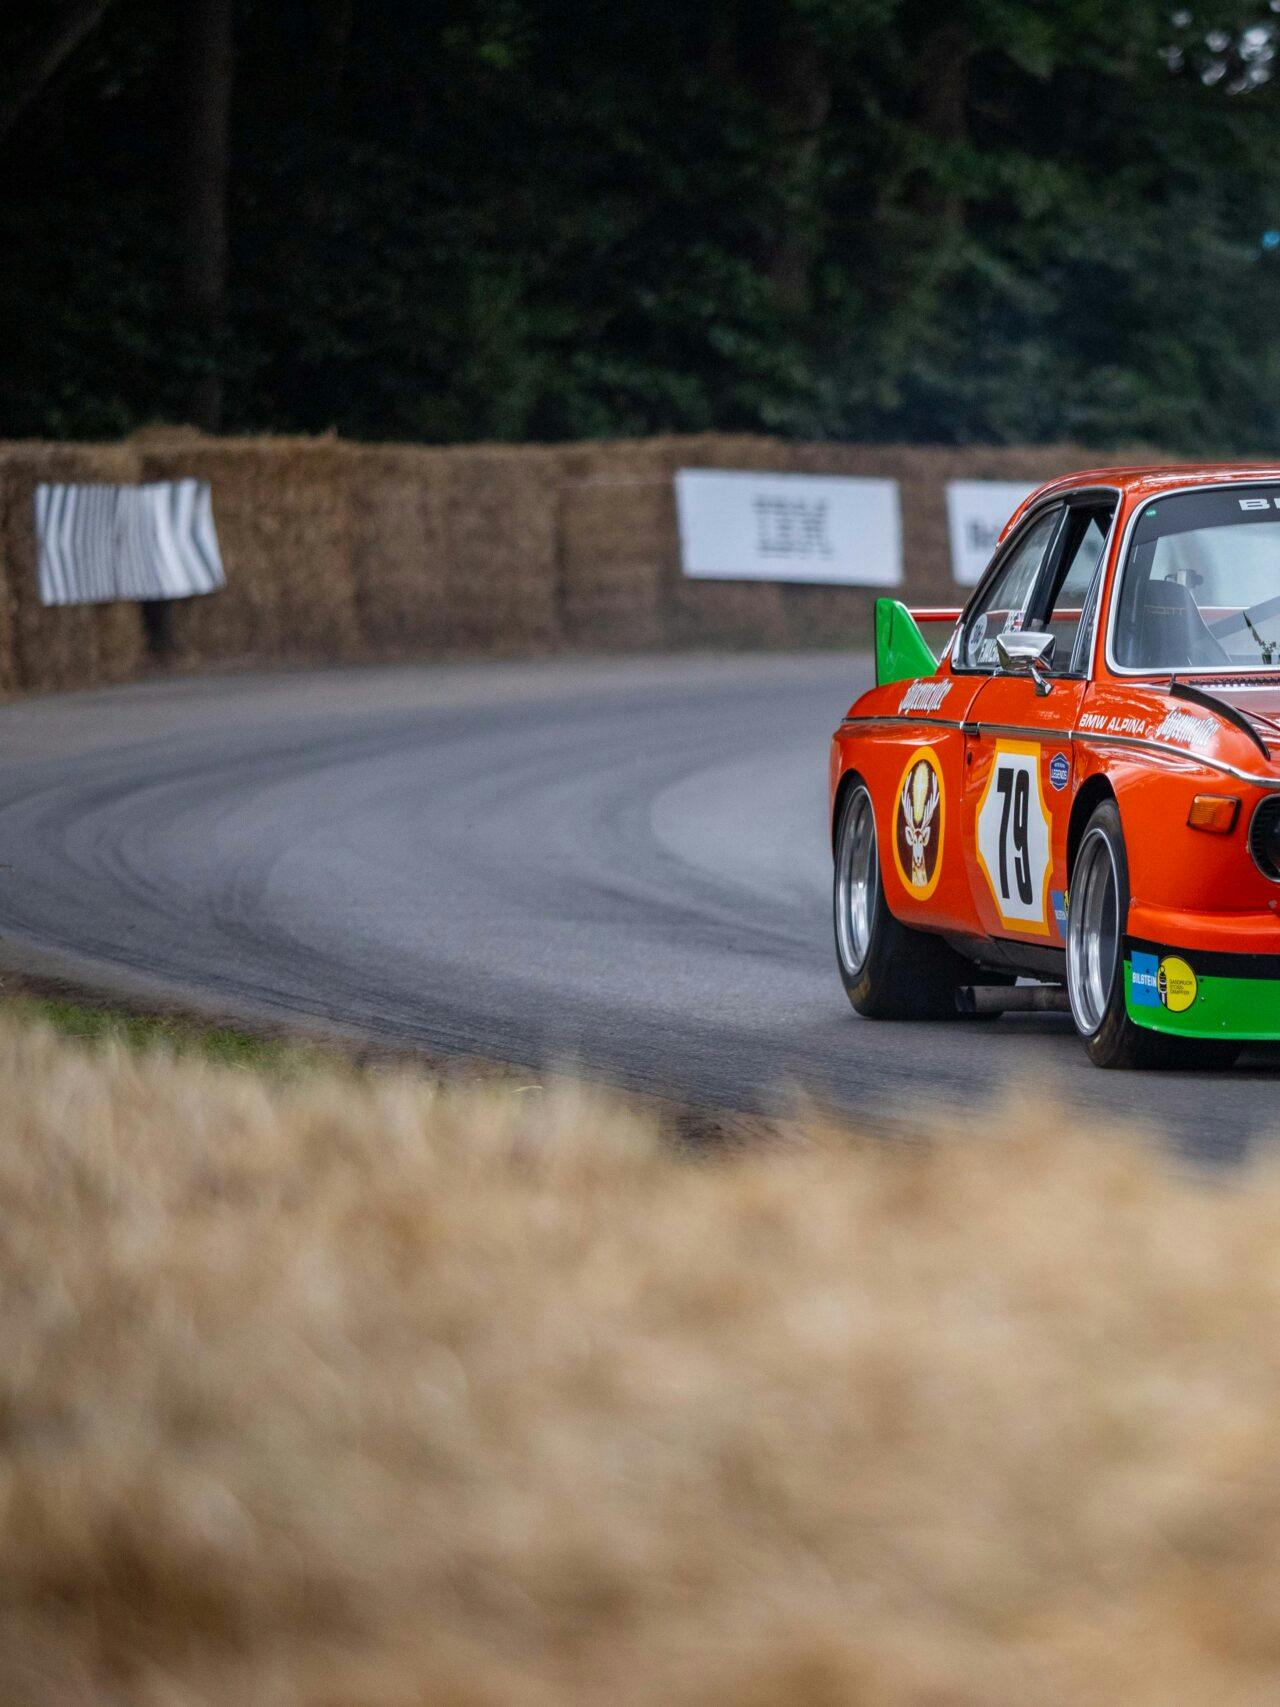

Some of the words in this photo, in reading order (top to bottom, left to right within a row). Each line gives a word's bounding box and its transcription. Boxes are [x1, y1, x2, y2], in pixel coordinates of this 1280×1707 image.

[1079, 713, 1107, 729] BMW
[1106, 716, 1146, 734] ALPINA
[997, 767, 1033, 905] 79
[1132, 971, 1157, 988] BILSTEIN
